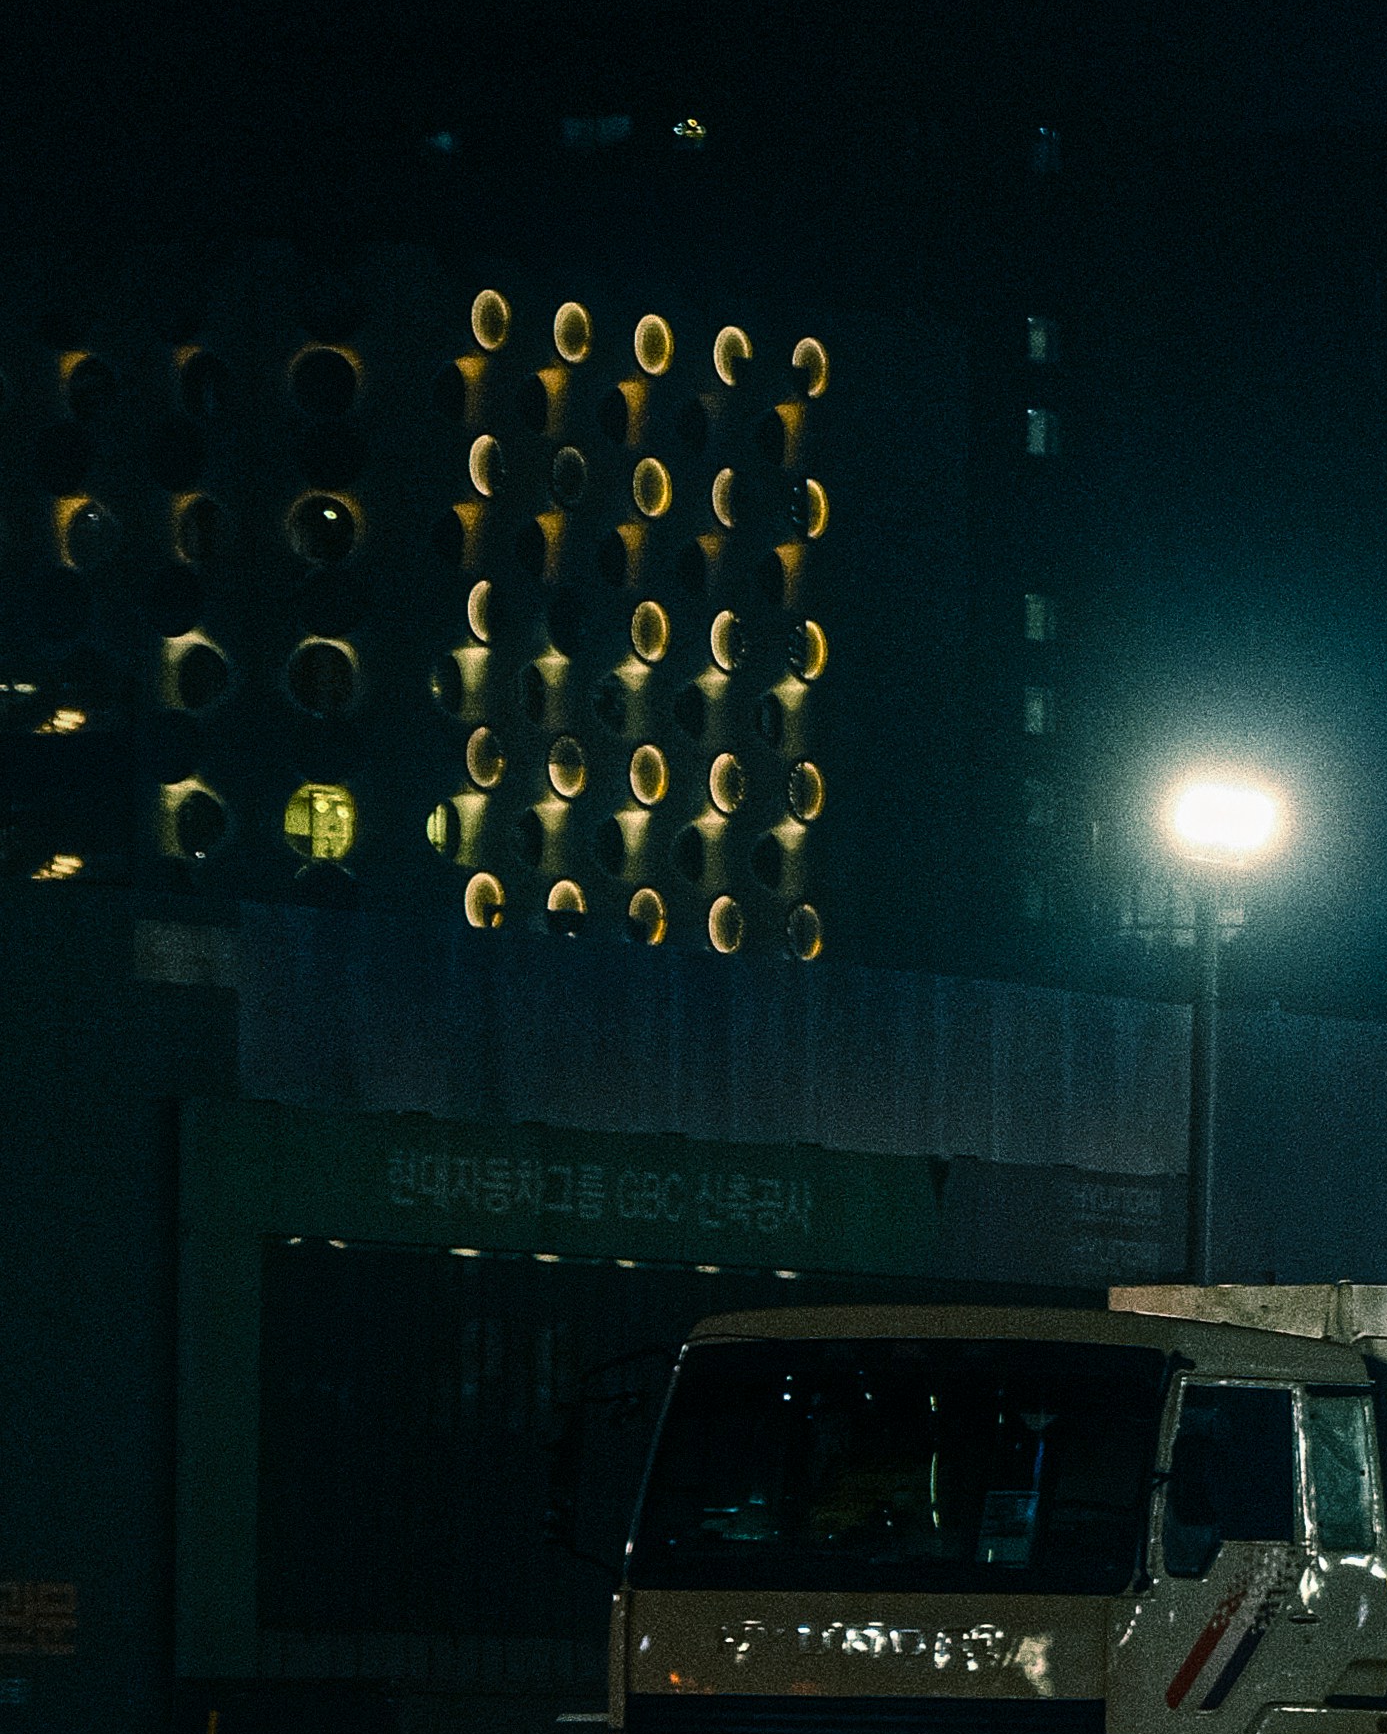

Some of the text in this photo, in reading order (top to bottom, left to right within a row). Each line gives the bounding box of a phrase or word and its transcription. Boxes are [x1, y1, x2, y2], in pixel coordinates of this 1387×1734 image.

[387, 1149, 813, 1234] 현대자동차그룹 GBC 신축공사
